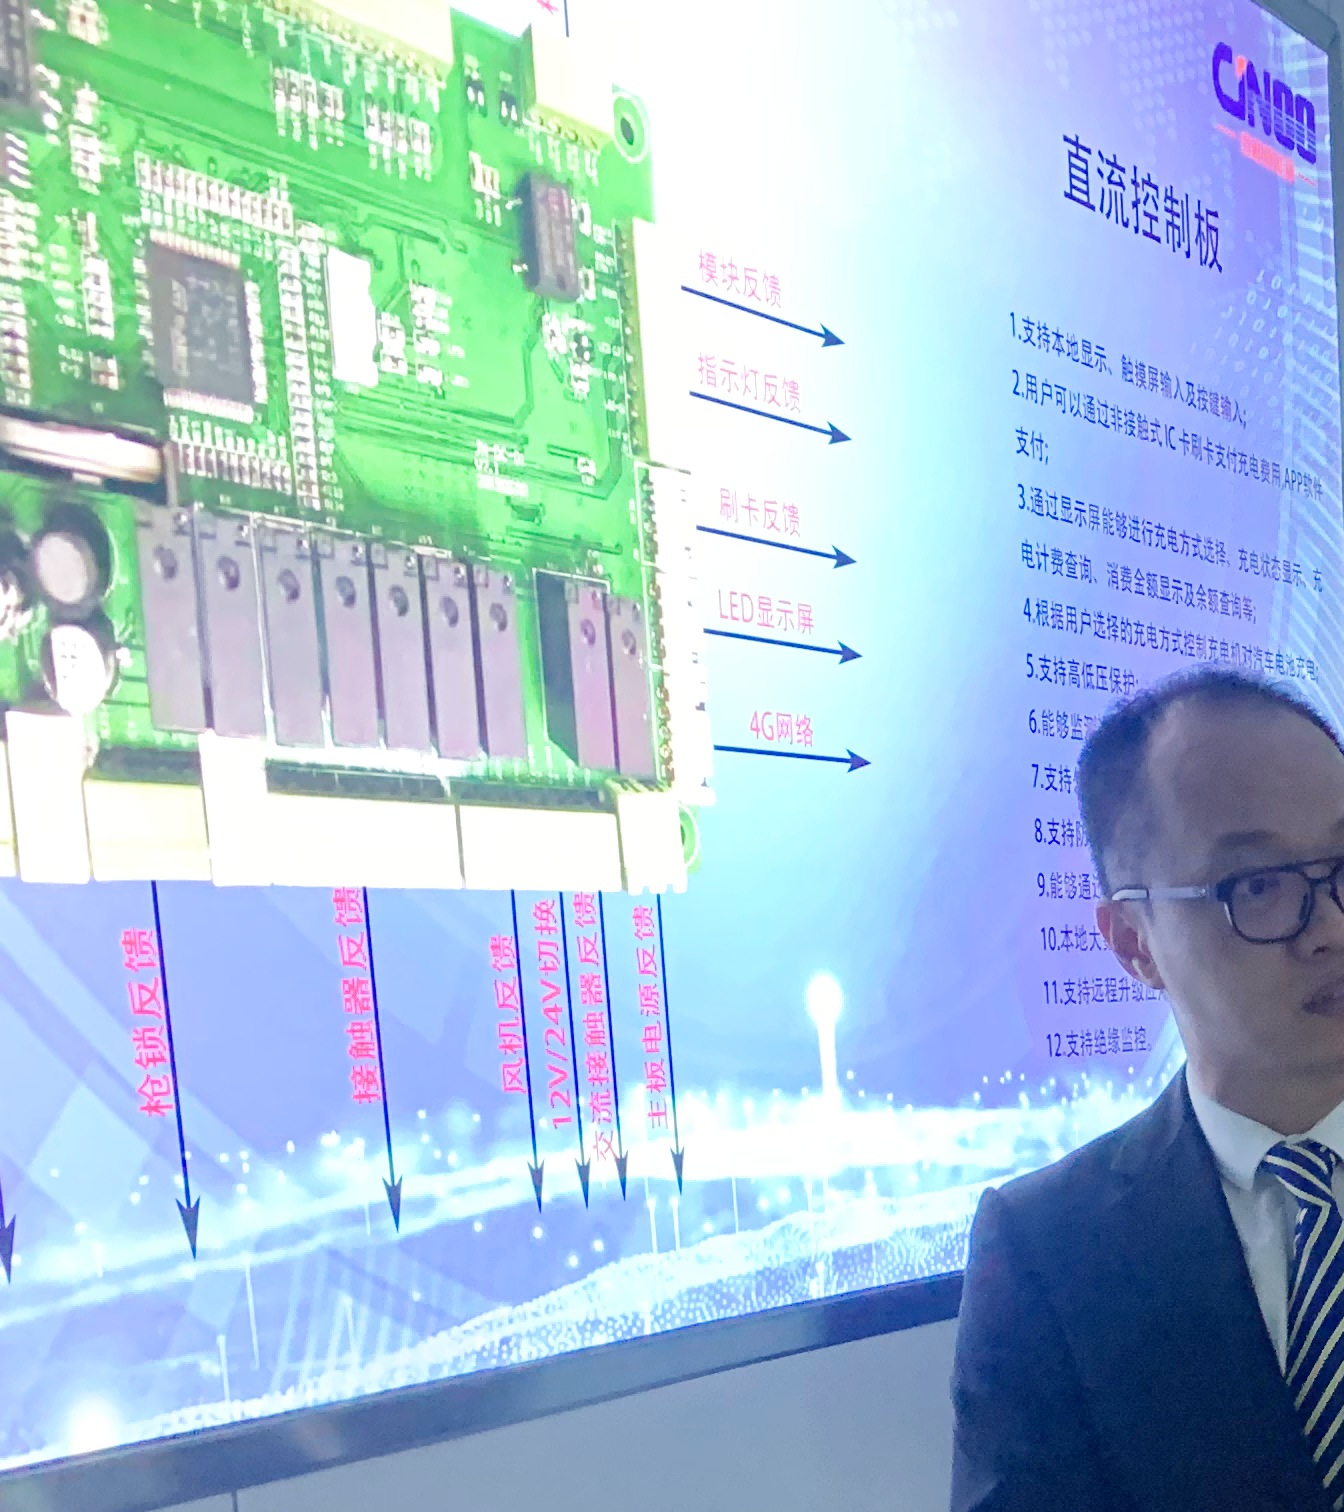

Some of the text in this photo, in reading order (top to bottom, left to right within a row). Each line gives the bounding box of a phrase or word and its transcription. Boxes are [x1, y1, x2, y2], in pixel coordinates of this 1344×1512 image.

[697, 247, 783, 309] 模块反馈
[1062, 133, 1223, 273] 直流控制板
[697, 351, 801, 414] 指示灯反馈
[718, 486, 801, 538] 刷卡反馈
[717, 588, 815, 636] LED显示屏
[749, 709, 814, 748] 4G网络
[119, 927, 175, 1117] 枪锁反馈
[331, 886, 382, 1104] 接触器反馈
[488, 933, 527, 1095] 风机反馈
[532, 898, 573, 1130] 12V/24V切换
[572, 890, 616, 1162] 交流接触器反馈
[631, 905, 668, 1129] 主板电源反馈
